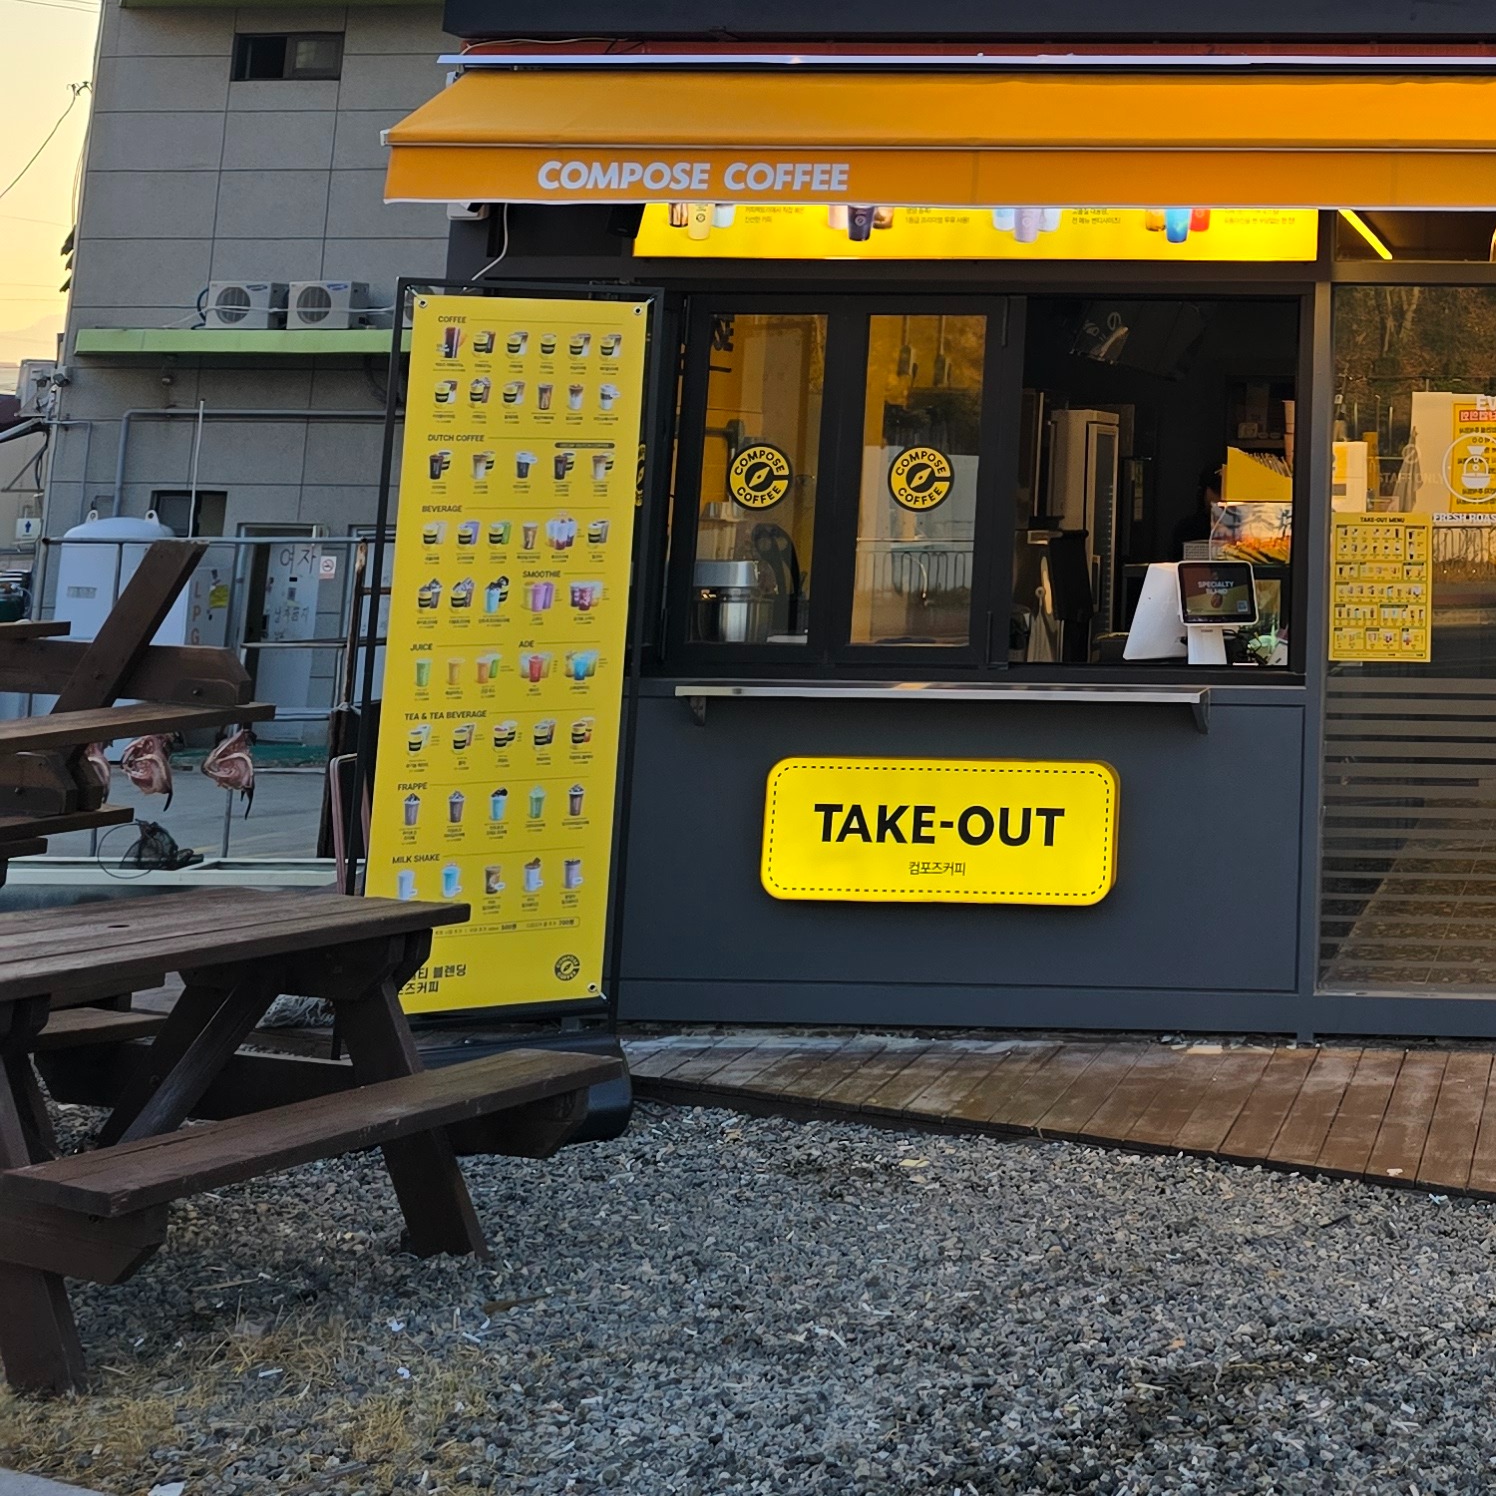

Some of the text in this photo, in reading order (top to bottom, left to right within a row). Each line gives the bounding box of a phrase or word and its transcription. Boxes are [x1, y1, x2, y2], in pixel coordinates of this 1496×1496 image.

[538, 161, 850, 192] COMPOSE COFFEE
[438, 315, 467, 323] COFFEE
[427, 434, 485, 442] DUTCH COFFEE
[733, 449, 785, 476] COMPOSE
[895, 450, 946, 476] COMPOSE
[736, 485, 782, 505] COFFEE
[897, 485, 943, 505] COFFEE
[422, 504, 463, 513] BEVERAGE
[1433, 513, 1467, 524] FRESH
[280, 545, 317, 574] 여자
[522, 570, 561, 579] SMOOTHIE
[410, 643, 433, 652] JUICE
[518, 640, 535, 649] ADE
[405, 713, 419, 721] TEA
[429, 712, 444, 720] TEA
[446, 710, 487, 719] BEVERAGE
[397, 782, 428, 791] FRAPPE
[814, 803, 1065, 847] TAKE-OUT
[392, 853, 440, 865] MILK SHAKE
[908, 861, 966, 876] 컴포즈커피
[433, 964, 467, 978] 블렌딩
